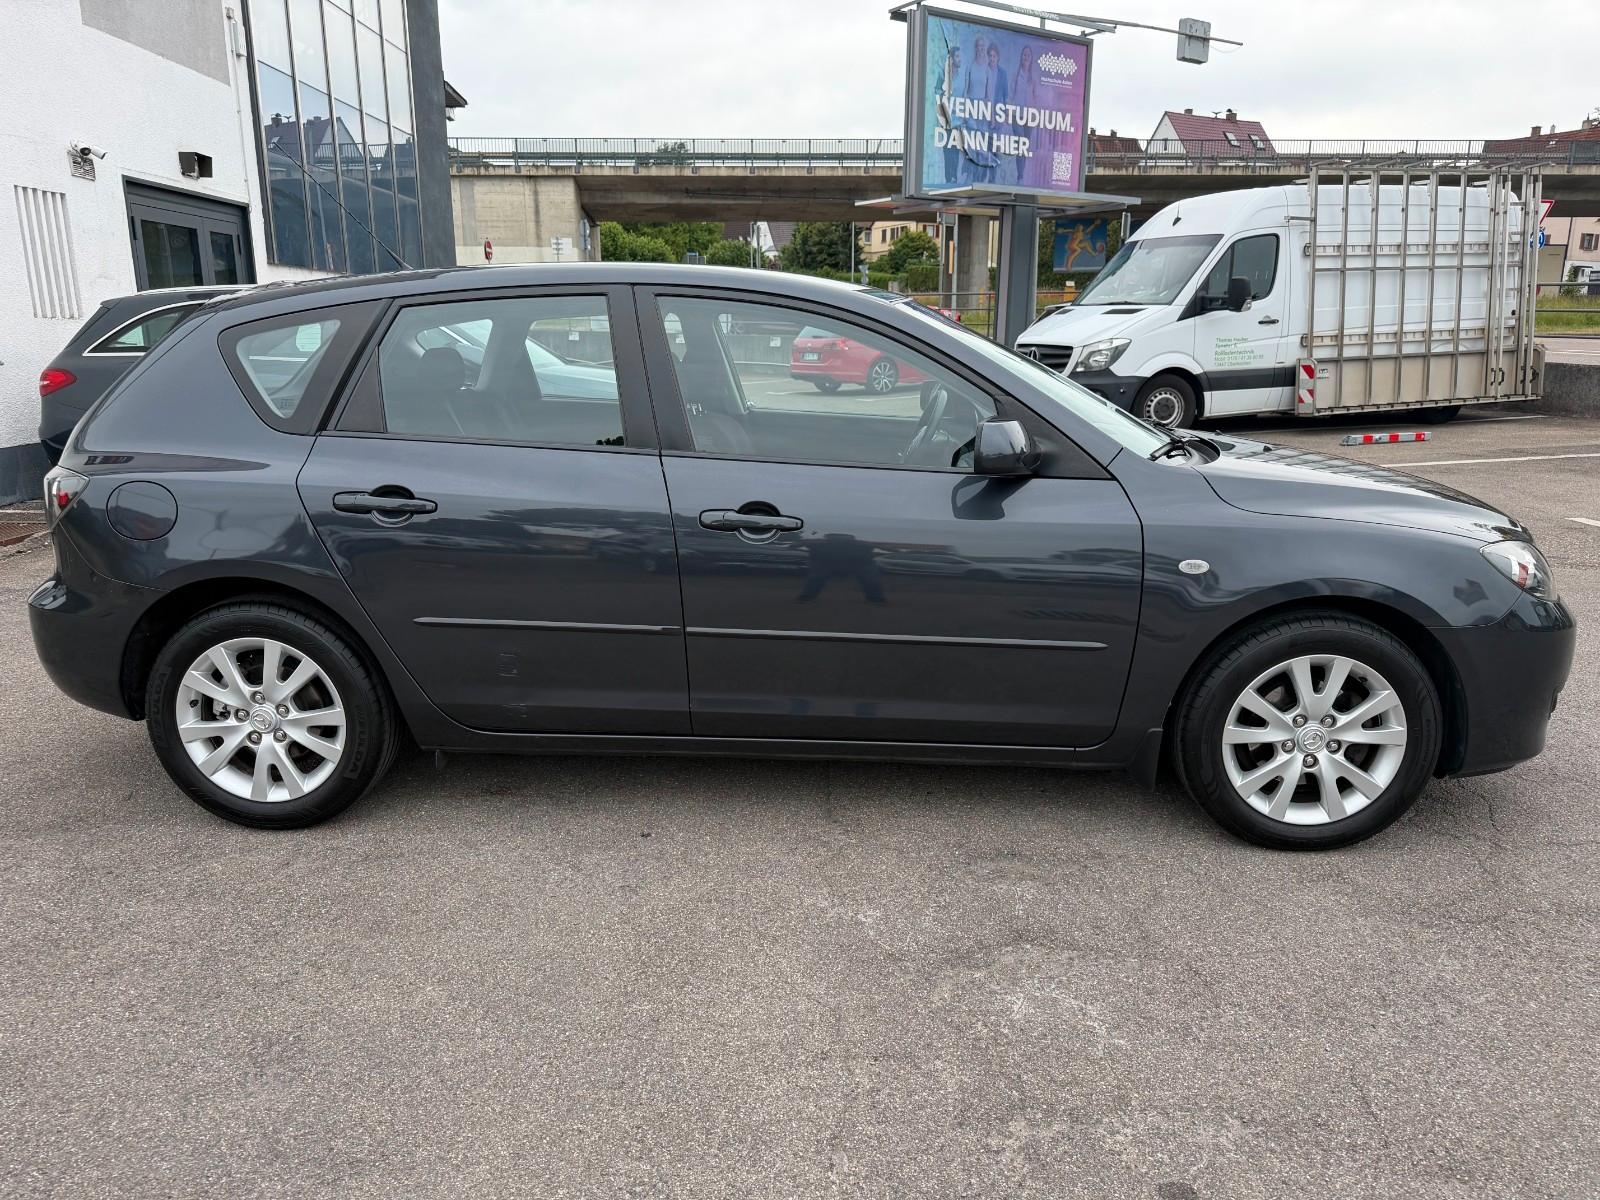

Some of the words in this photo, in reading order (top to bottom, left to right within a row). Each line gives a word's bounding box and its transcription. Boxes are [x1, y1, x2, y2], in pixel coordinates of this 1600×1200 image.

[935, 95, 991, 121] WENN
[995, 103, 1075, 133] STUDIUM.
[934, 127, 989, 152] DANN
[992, 133, 1033, 157] HIER.
